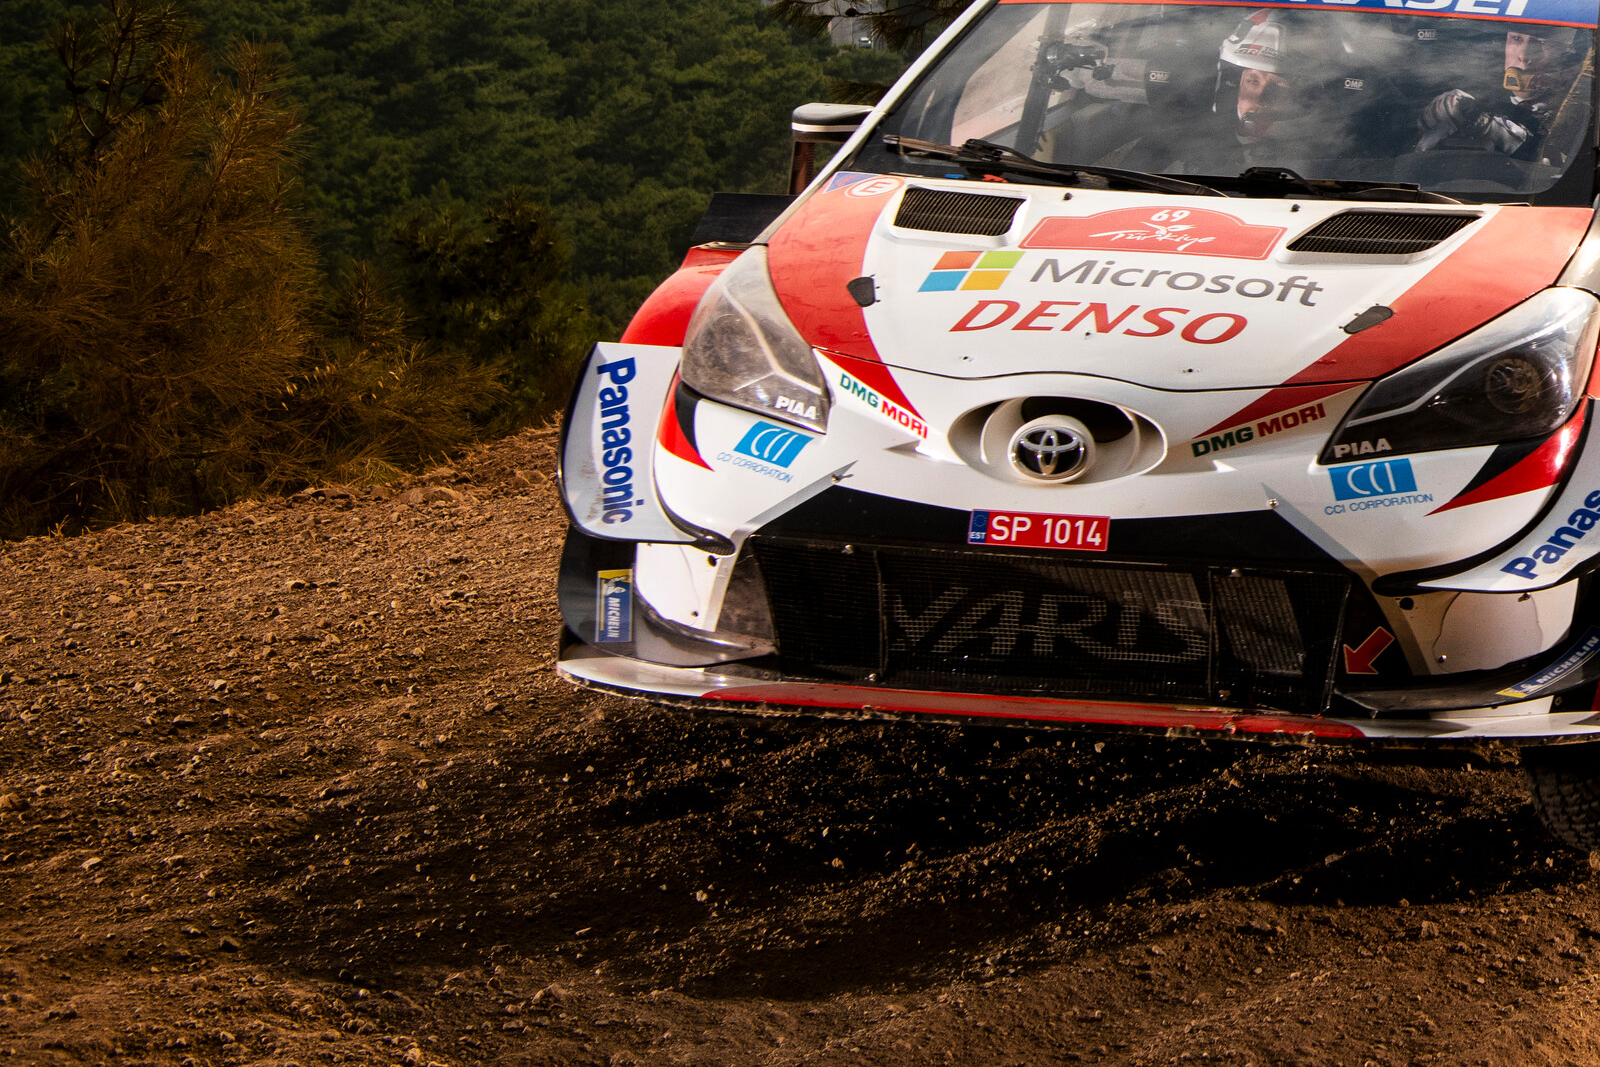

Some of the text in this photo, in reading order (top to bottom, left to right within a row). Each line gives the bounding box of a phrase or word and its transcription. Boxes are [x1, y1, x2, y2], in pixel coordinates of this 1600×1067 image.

[1150, 209, 1192, 222] 69
[1029, 257, 1324, 308] Microsoft
[948, 299, 1249, 345] DENSO
[773, 395, 817, 421] PIAA
[839, 372, 929, 440] DMG MORI
[596, 356, 645, 525] Panasonic
[1191, 402, 1327, 458] DMG MORI
[1333, 437, 1393, 459] PIAA
[1323, 493, 1434, 516] CCI CORPORATION
[969, 531, 987, 540] EST
[990, 515, 1103, 546] SP 1014
[607, 596, 621, 638] MICHELIN
[1535, 635, 1600, 686] MICHELIN
